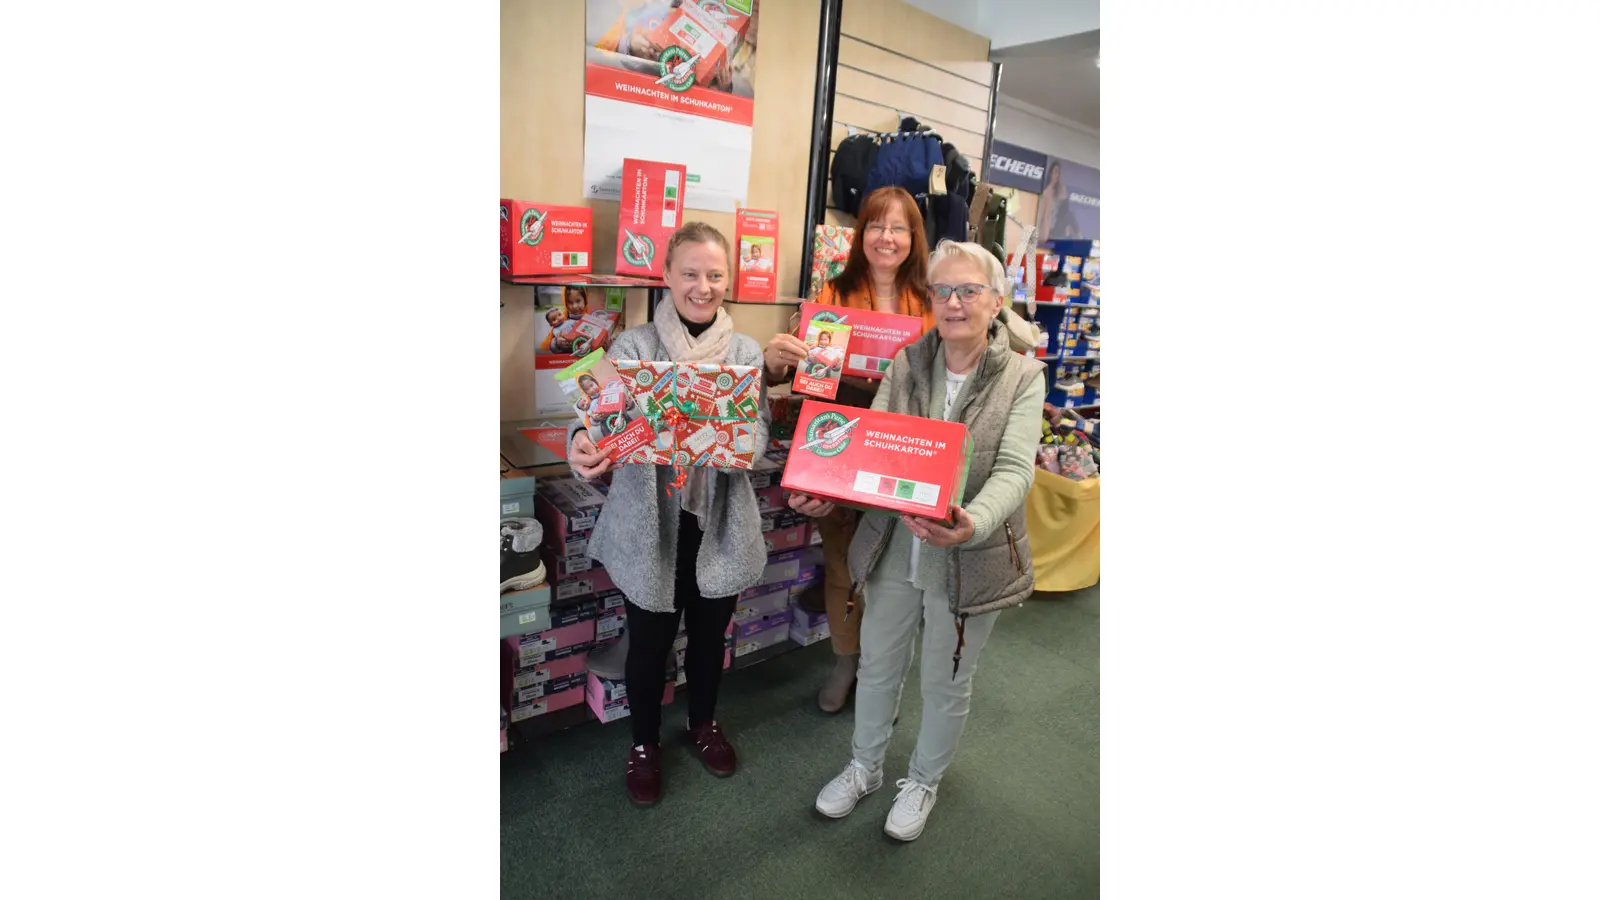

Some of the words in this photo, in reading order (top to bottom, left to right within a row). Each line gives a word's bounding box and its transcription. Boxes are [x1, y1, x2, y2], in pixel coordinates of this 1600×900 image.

[615, 82, 670, 101] WEIHNACHTEN
[670, 95, 679, 103] IM
[853, 324, 902, 336] WEIHNACHTEN
[609, 442, 618, 450] EI
[618, 430, 636, 446] AUCH
[635, 425, 645, 434] DU
[618, 436, 640, 452] DABEI!
[865, 429, 933, 448] WEIHNACHTEN
[935, 441, 947, 450] IM
